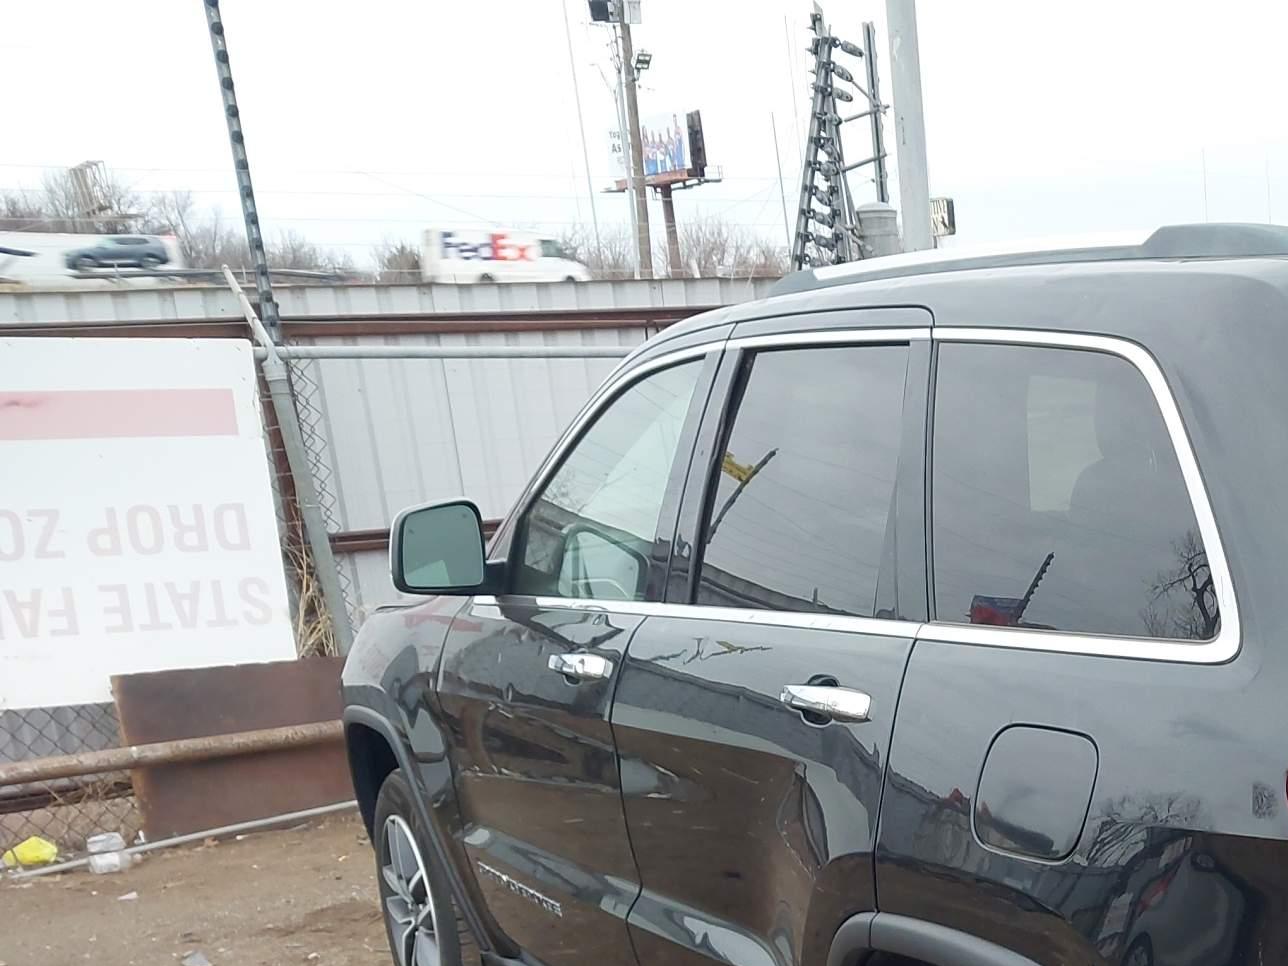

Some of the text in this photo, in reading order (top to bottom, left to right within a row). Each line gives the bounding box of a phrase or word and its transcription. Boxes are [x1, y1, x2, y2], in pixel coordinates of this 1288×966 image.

[440, 231, 536, 262] FedEx
[87, 501, 252, 558] DROP
[0, 575, 273, 640] STATE FA
